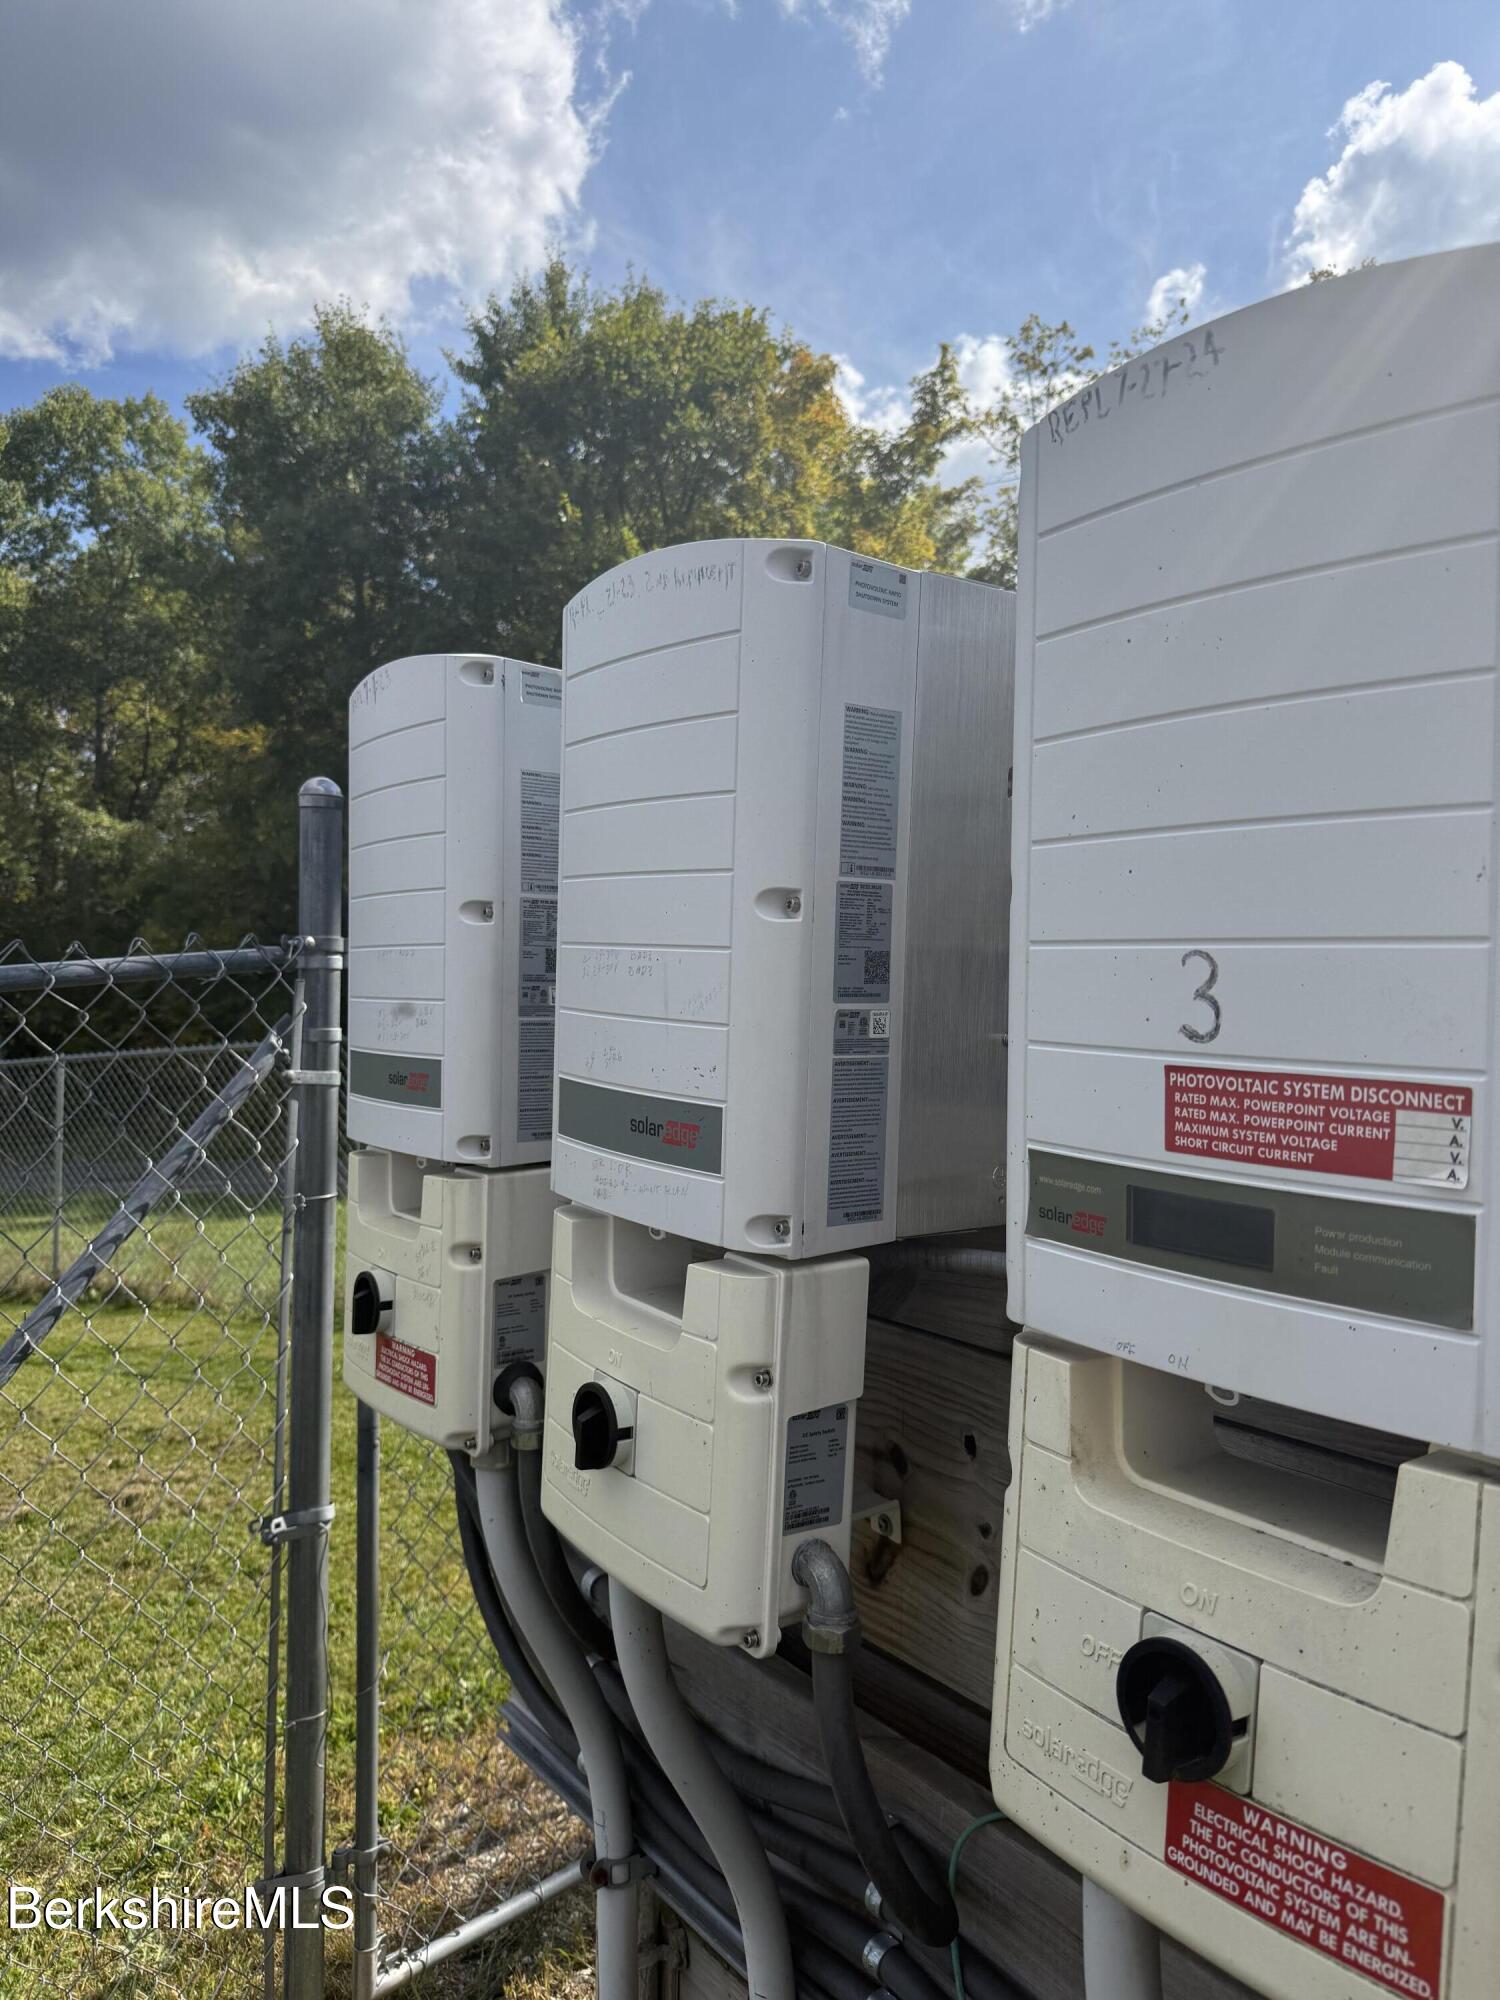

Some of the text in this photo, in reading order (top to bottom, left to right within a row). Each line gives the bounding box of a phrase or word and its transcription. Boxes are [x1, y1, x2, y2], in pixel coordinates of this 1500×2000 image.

[1178, 949, 1222, 1044] 3
[1169, 1072, 1465, 1112] PHOTOVOLTAIC SYSTEM DISCONNECT
[1174, 1092, 1464, 1130] RATED MAX. POWERPOINT VOLTAGE V.
[1174, 1107, 1463, 1148] RATED MAX. POWERPOINT CURRENT A.
[1174, 1121, 1462, 1165] MAXIMUM SYSTEM VOLTAGE V.
[1174, 1135, 1461, 1181] SHORT CIRCUIT CURRENT A.
[1314, 1226, 1403, 1248] Power production
[1314, 1243, 1432, 1271] Module communication
[1313, 1262, 1339, 1276] Fault
[1168, 1353, 1190, 1371] ON
[1179, 1581, 1219, 1617] ON
[1080, 1633, 1123, 1669] OFF
[1021, 1719, 1134, 1809] solaredge
[1243, 1805, 1348, 1870] WARNING
[1189, 1818, 1409, 1944] THE DC CONDUCTORS OF THIS
[1194, 1802, 1404, 1920] ELECTRICAL SHOCK HAZARD.
[1167, 1846, 1240, 1896] GROUNDED
[1243, 1890, 1277, 1917] AND
[1280, 1909, 1314, 1937] MAY
[1318, 1928, 1338, 1951] BE
[1182, 1834, 1416, 1967] PHOTOVOLTAIC SYSTEM ARE UN-
